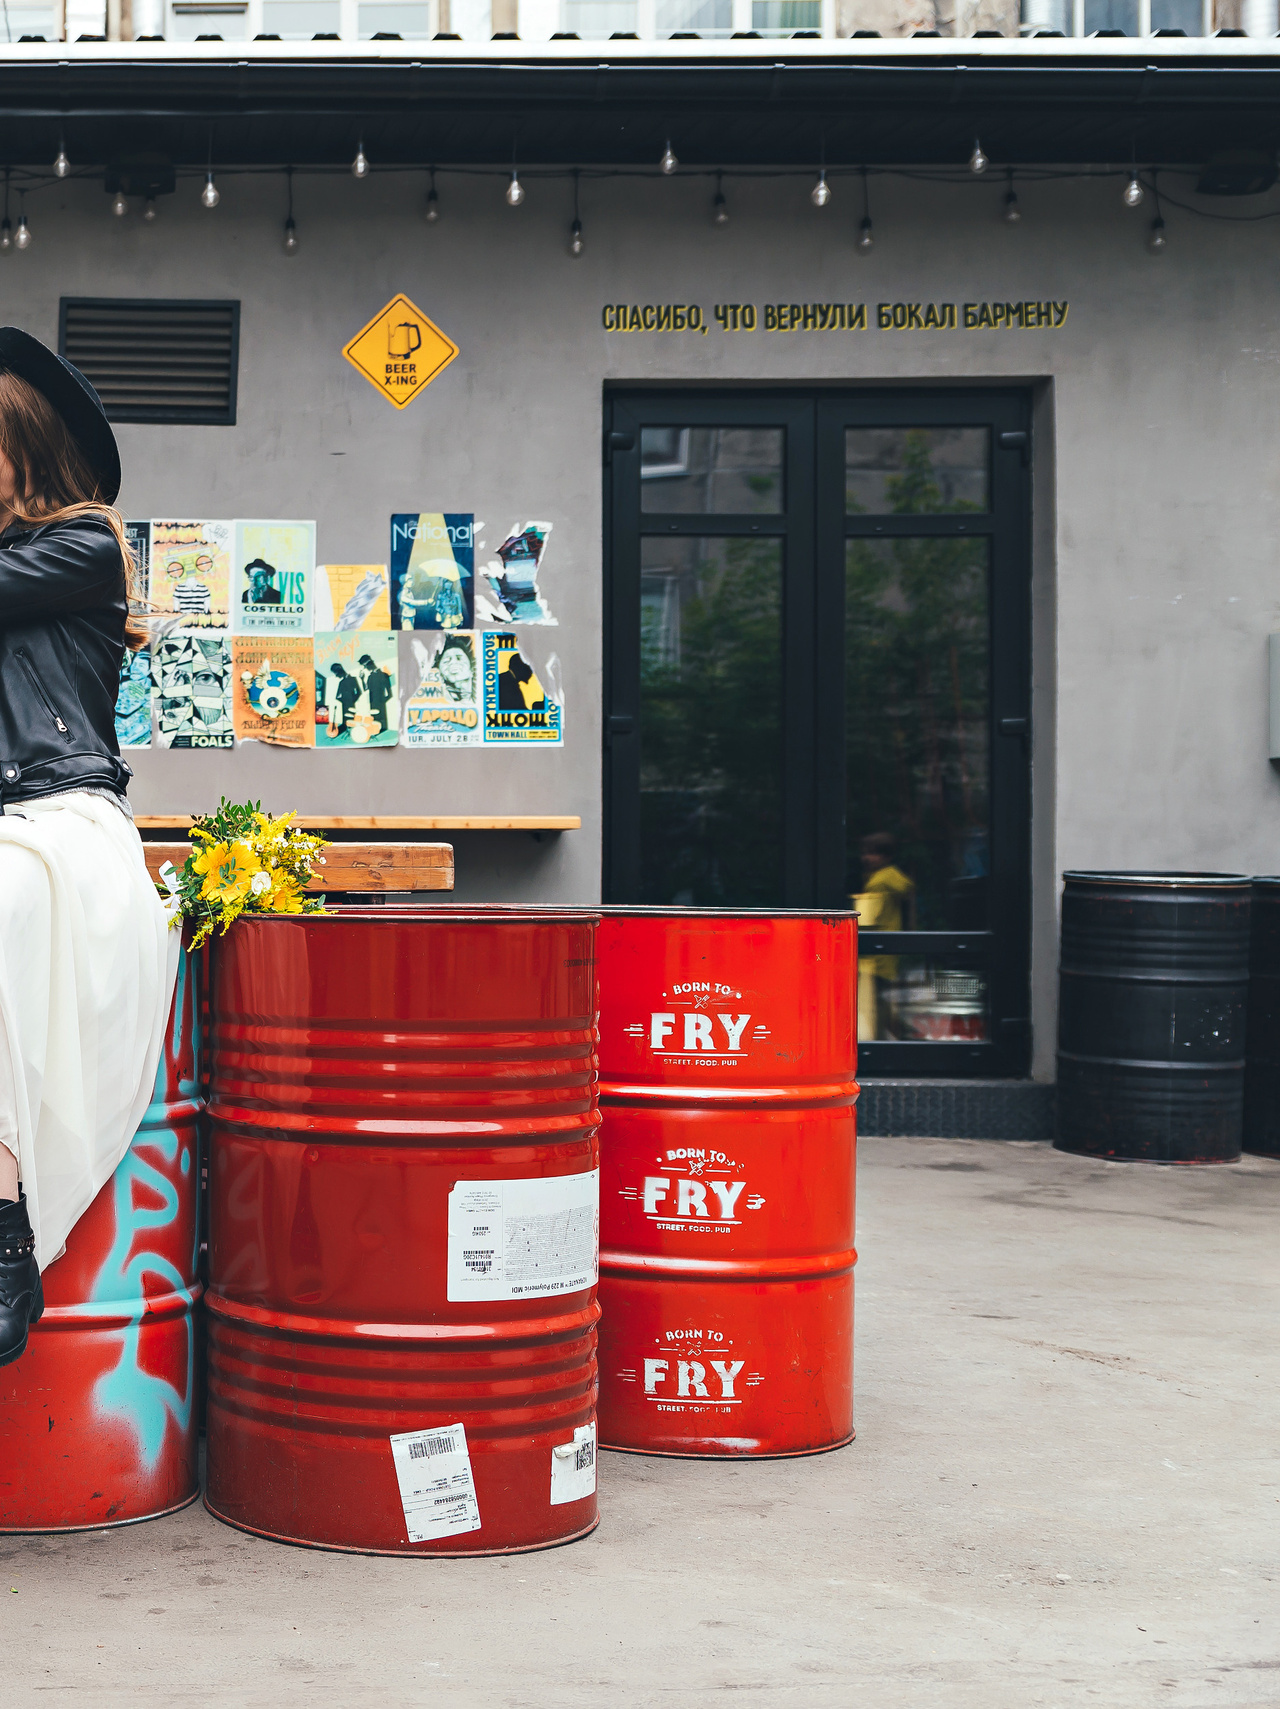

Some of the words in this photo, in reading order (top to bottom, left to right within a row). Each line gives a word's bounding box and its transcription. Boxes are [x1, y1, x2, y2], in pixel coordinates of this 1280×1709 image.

[602, 304, 708, 335] СПАСИБО,
[714, 304, 757, 332] ЧТО
[765, 304, 867, 331] ВЕРНУЛИ
[877, 303, 957, 330] БОКАЛ
[963, 301, 1069, 330] БАРМЕНУ
[385, 364, 417, 374] BEER
[384, 376, 418, 386] X-ING
[393, 522, 474, 552] National
[276, 571, 305, 605] VIS
[244, 605, 305, 614] COSTELLO
[413, 686, 445, 698] OWN
[422, 709, 478, 729] APOLLO
[191, 736, 233, 747] FOALS
[431, 735, 452, 743] JULY
[672, 981, 710, 995] BORN
[714, 982, 731, 995] TO
[649, 1012, 752, 1051] FRY
[695, 1059, 720, 1067] FOOD.
[721, 1059, 738, 1067] PUB
[666, 1147, 706, 1161] BORN
[709, 1150, 727, 1164] TO
[643, 1176, 747, 1219] FRY
[656, 1223, 687, 1232] STREET.
[715, 1226, 731, 1234] PUB
[511, 1286, 524, 1294] MDI
[707, 1329, 724, 1342] TO
[642, 1357, 746, 1398] FRY
[656, 1404, 688, 1412] STREET.
